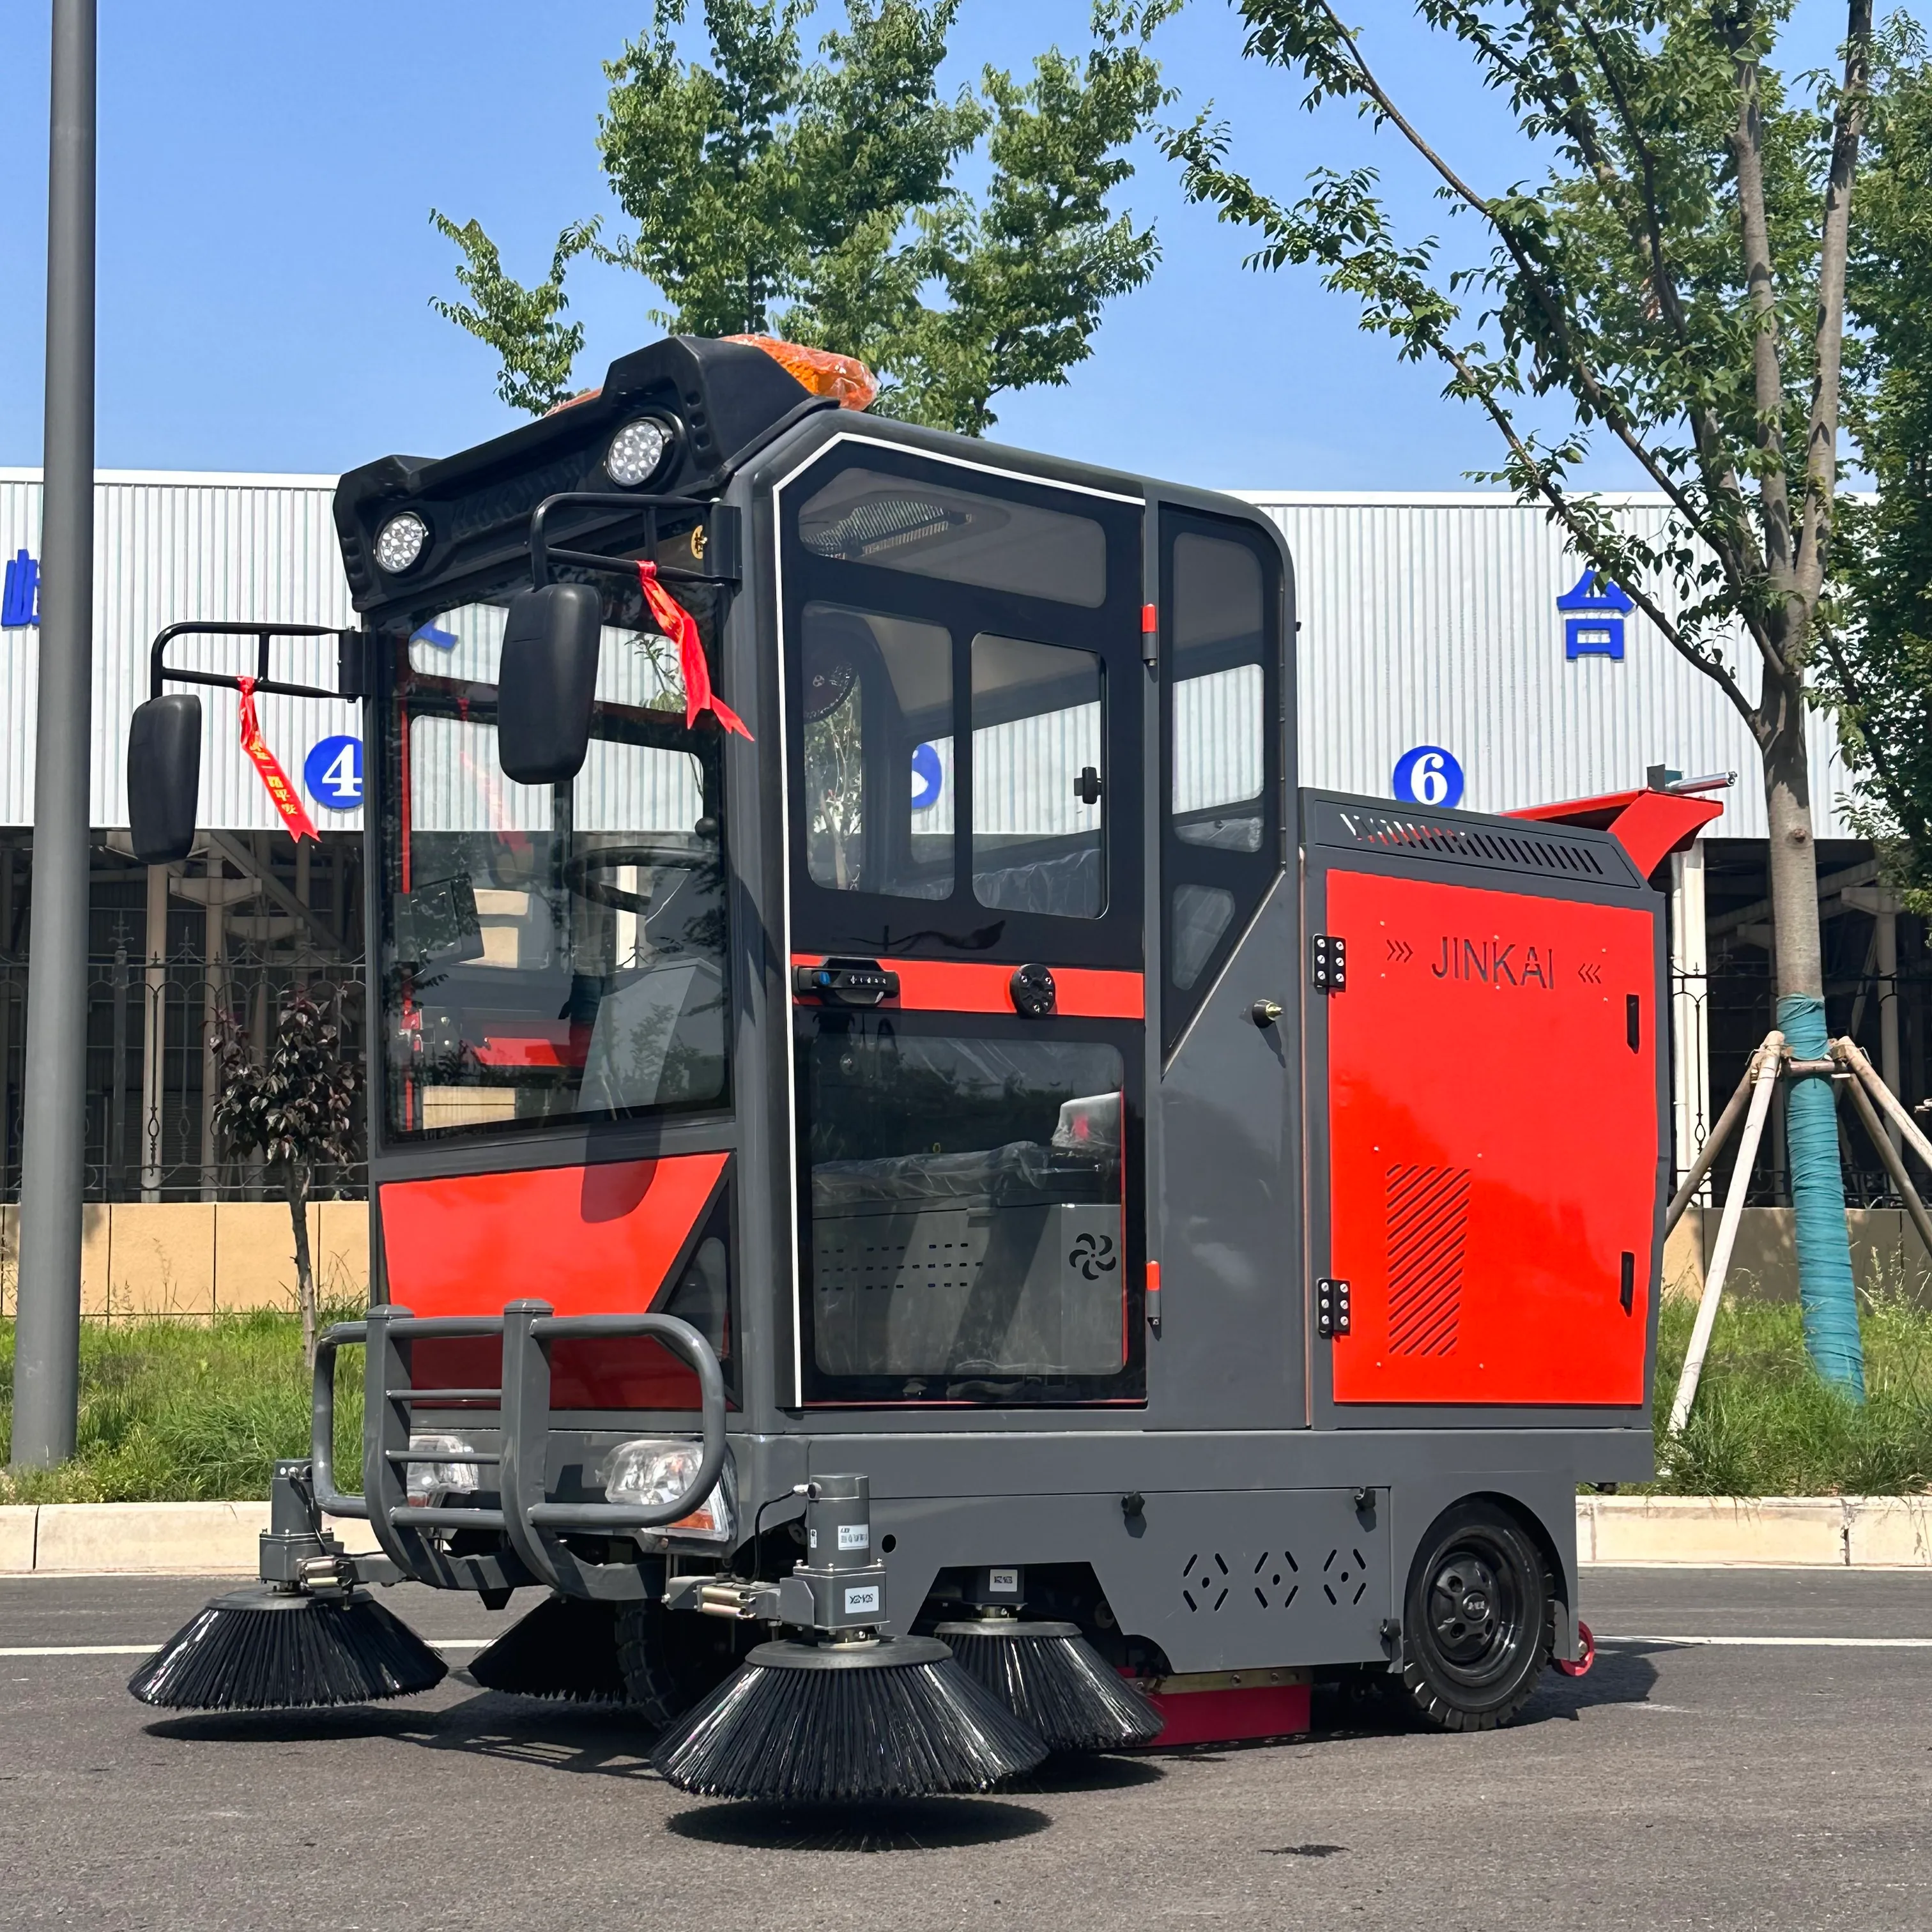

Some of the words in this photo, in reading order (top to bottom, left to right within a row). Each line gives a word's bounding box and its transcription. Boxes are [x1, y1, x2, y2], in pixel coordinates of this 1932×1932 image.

[1557, 569, 1636, 660] 合
[321, 744, 363, 797] 4
[1410, 753, 1448, 806] 6
[1431, 935, 1554, 990] JINKAI
